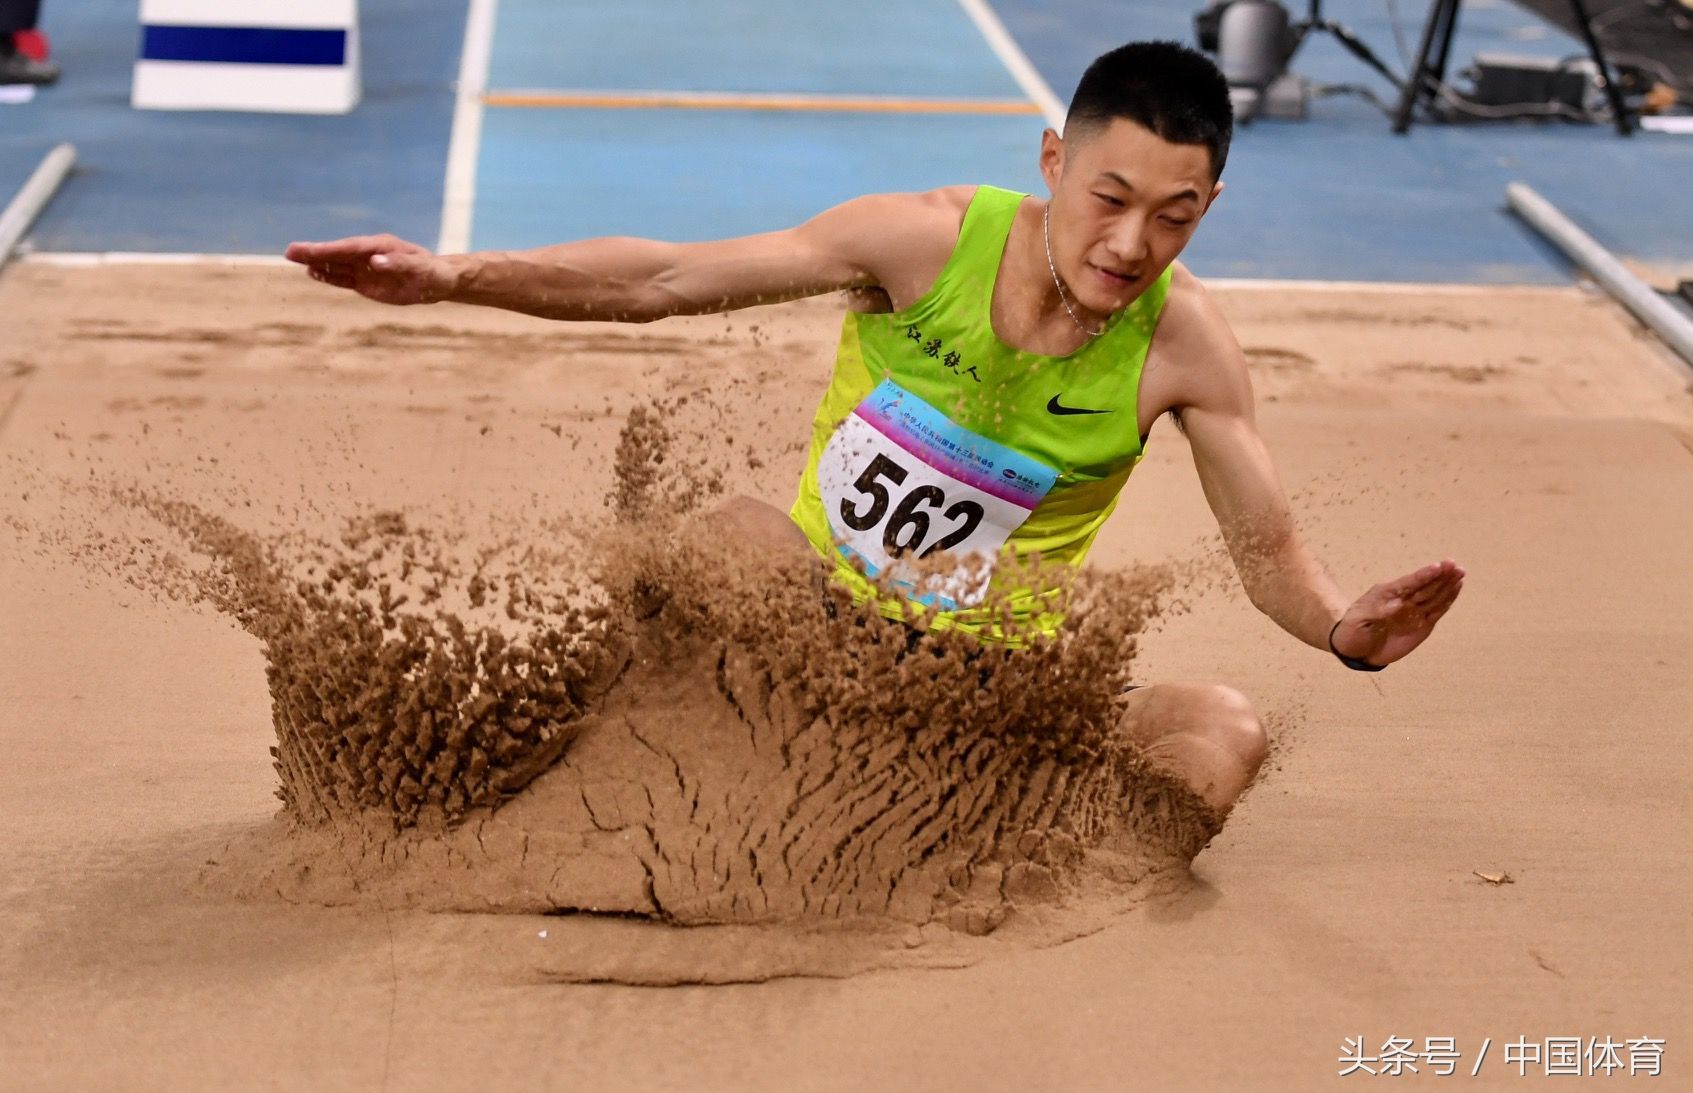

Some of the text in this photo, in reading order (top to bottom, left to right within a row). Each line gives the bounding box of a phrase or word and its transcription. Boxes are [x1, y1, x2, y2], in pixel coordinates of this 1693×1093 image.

[907, 324, 982, 383] 江苏铁人
[840, 452, 985, 560] 562
